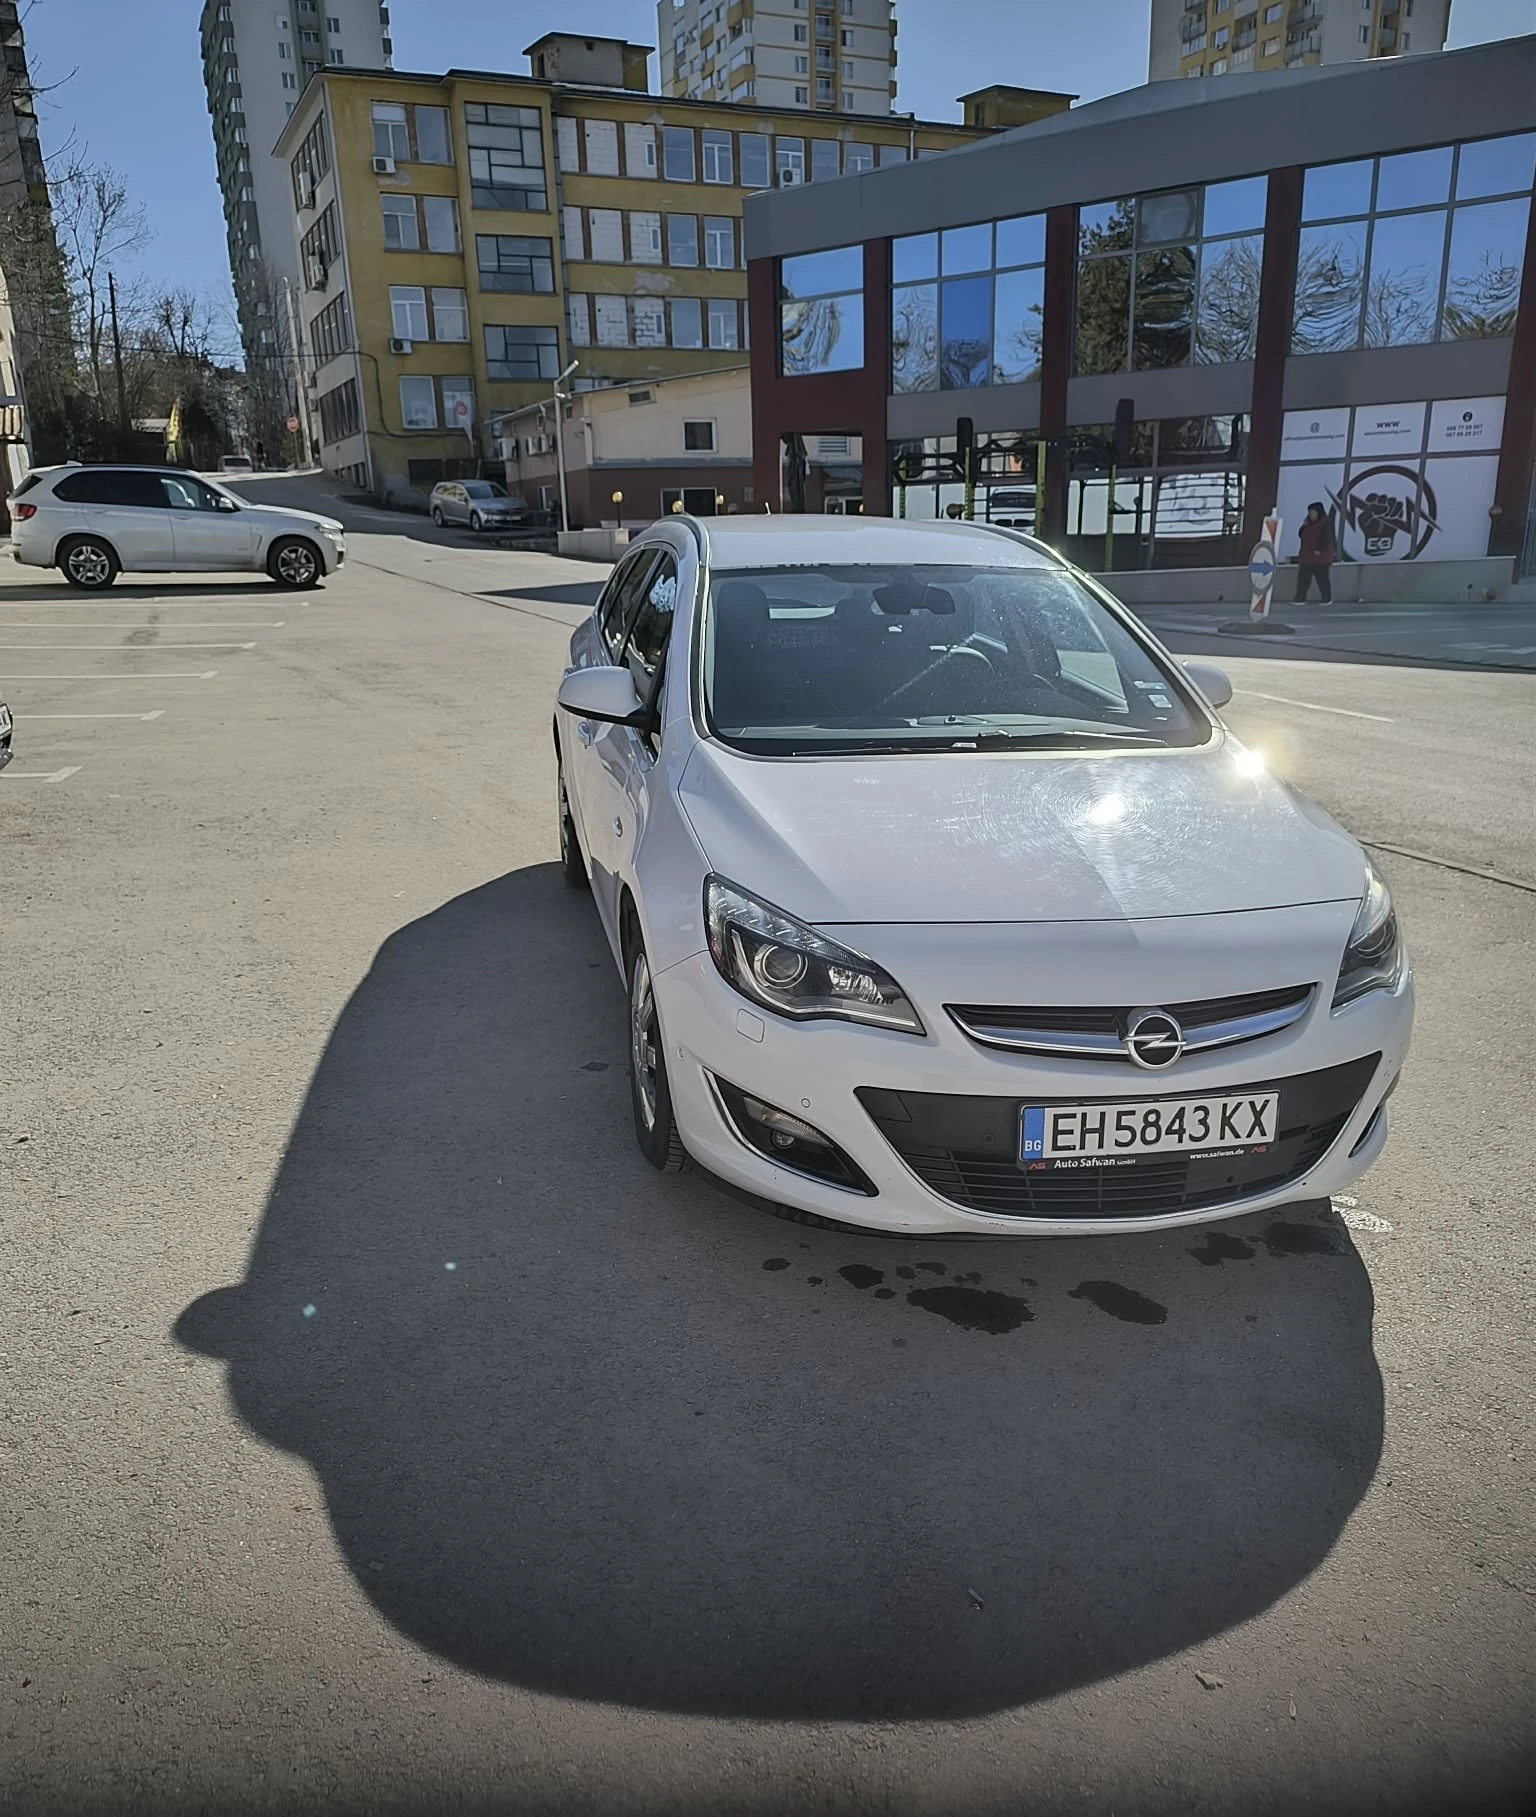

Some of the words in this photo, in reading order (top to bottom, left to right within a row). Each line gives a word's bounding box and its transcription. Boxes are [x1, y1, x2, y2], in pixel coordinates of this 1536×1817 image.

[1024, 1139, 1042, 1152] BG
[1054, 1159, 1078, 1169] Auto
[1080, 1157, 1116, 1167] Safwan
